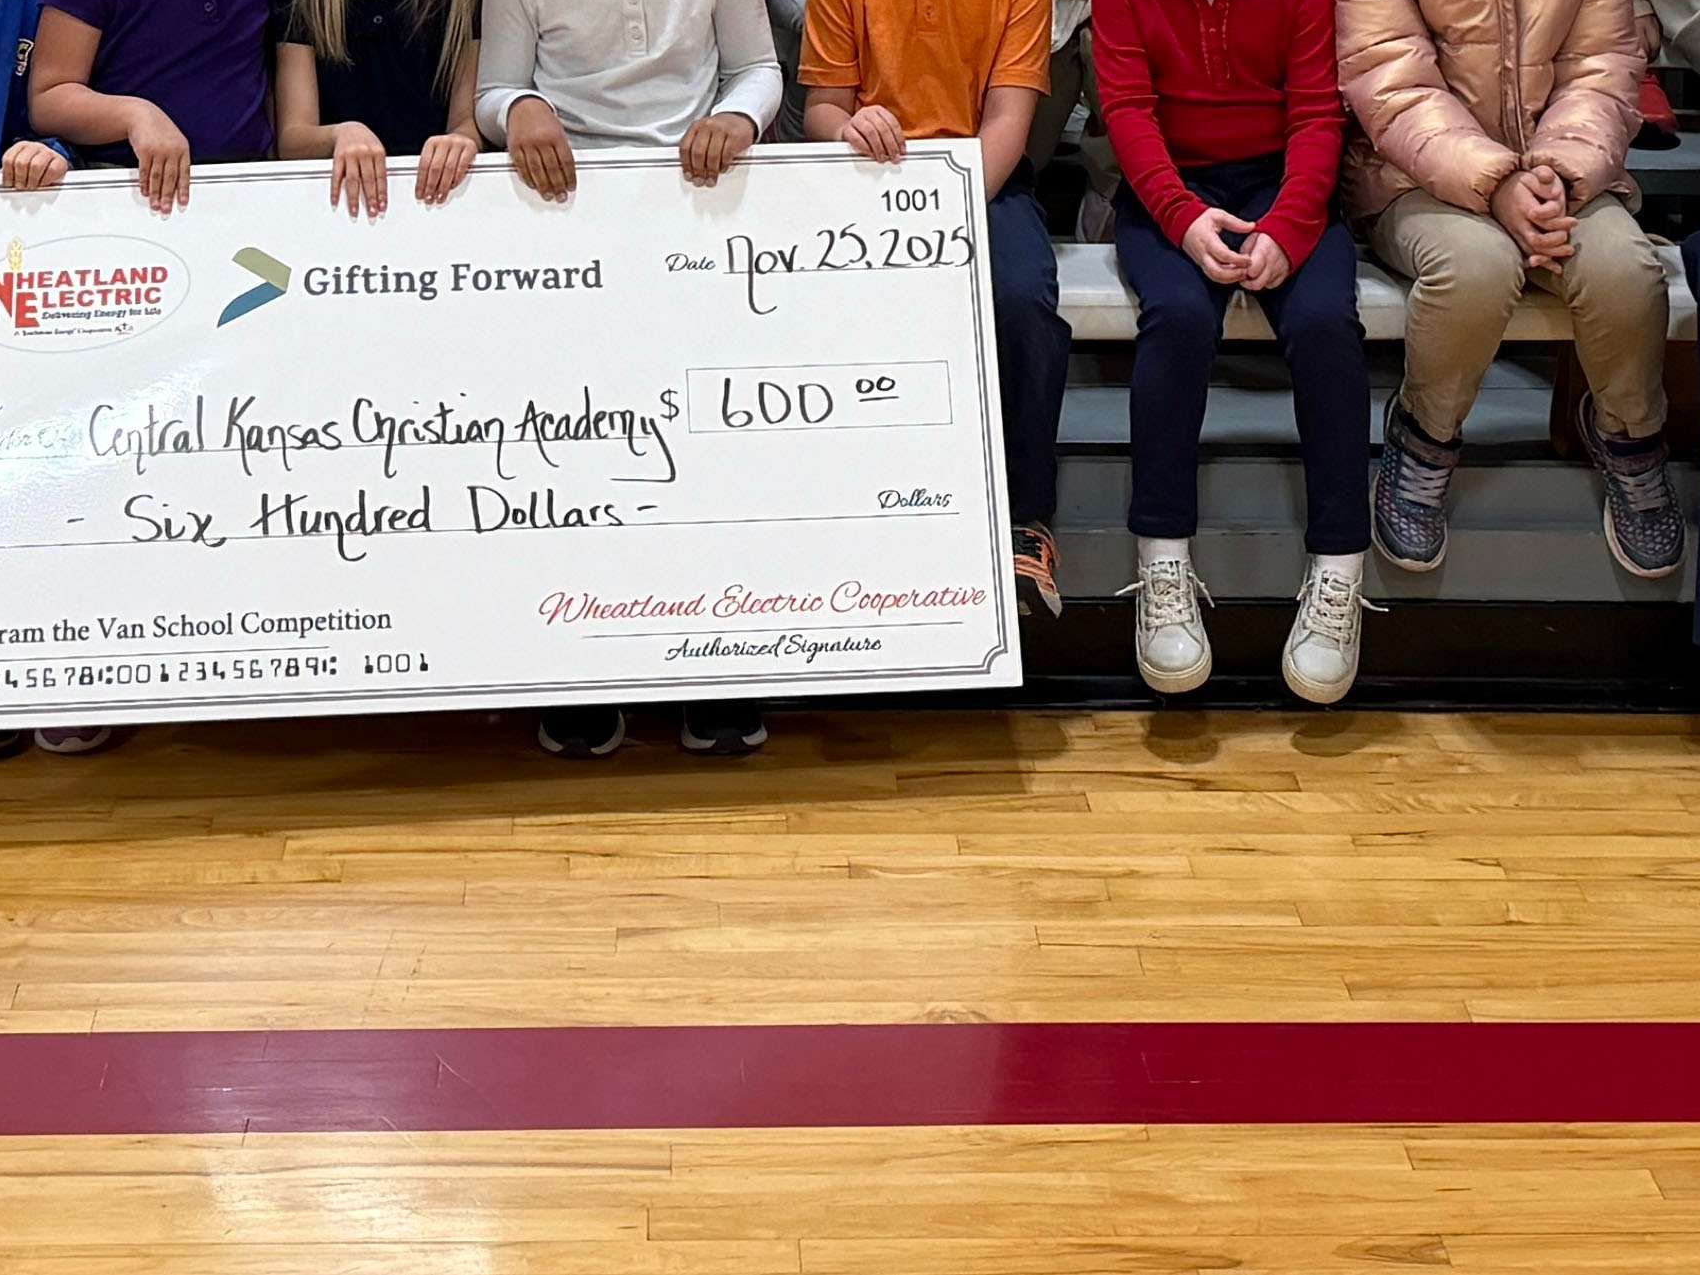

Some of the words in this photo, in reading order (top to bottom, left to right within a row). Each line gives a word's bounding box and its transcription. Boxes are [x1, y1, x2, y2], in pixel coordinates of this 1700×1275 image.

[881, 188, 940, 212] 1001
[665, 253, 716, 272] Date
[879, 226, 976, 268] 2025
[303, 264, 438, 301] Gifting
[451, 259, 603, 292] Forward
[14, 286, 163, 328] ELECTRIC
[659, 388, 680, 423] $
[721, 377, 834, 428] 600
[89, 394, 204, 475] Central
[223, 395, 342, 476] Kansas
[514, 386, 677, 483] Academy
[877, 488, 953, 510] Dollars
[124, 494, 228, 549] Six
[251, 484, 432, 562] Hundred
[466, 484, 625, 534] Dollars
[538, 590, 708, 627] Wheatland
[711, 583, 825, 620] Electric
[829, 580, 989, 617] Cooperative
[52, 618, 90, 642] the
[97, 617, 145, 640] Van
[152, 612, 234, 638] School
[240, 608, 393, 639] Competition
[663, 634, 784, 662] Authorized
[783, 633, 883, 664] Signature
